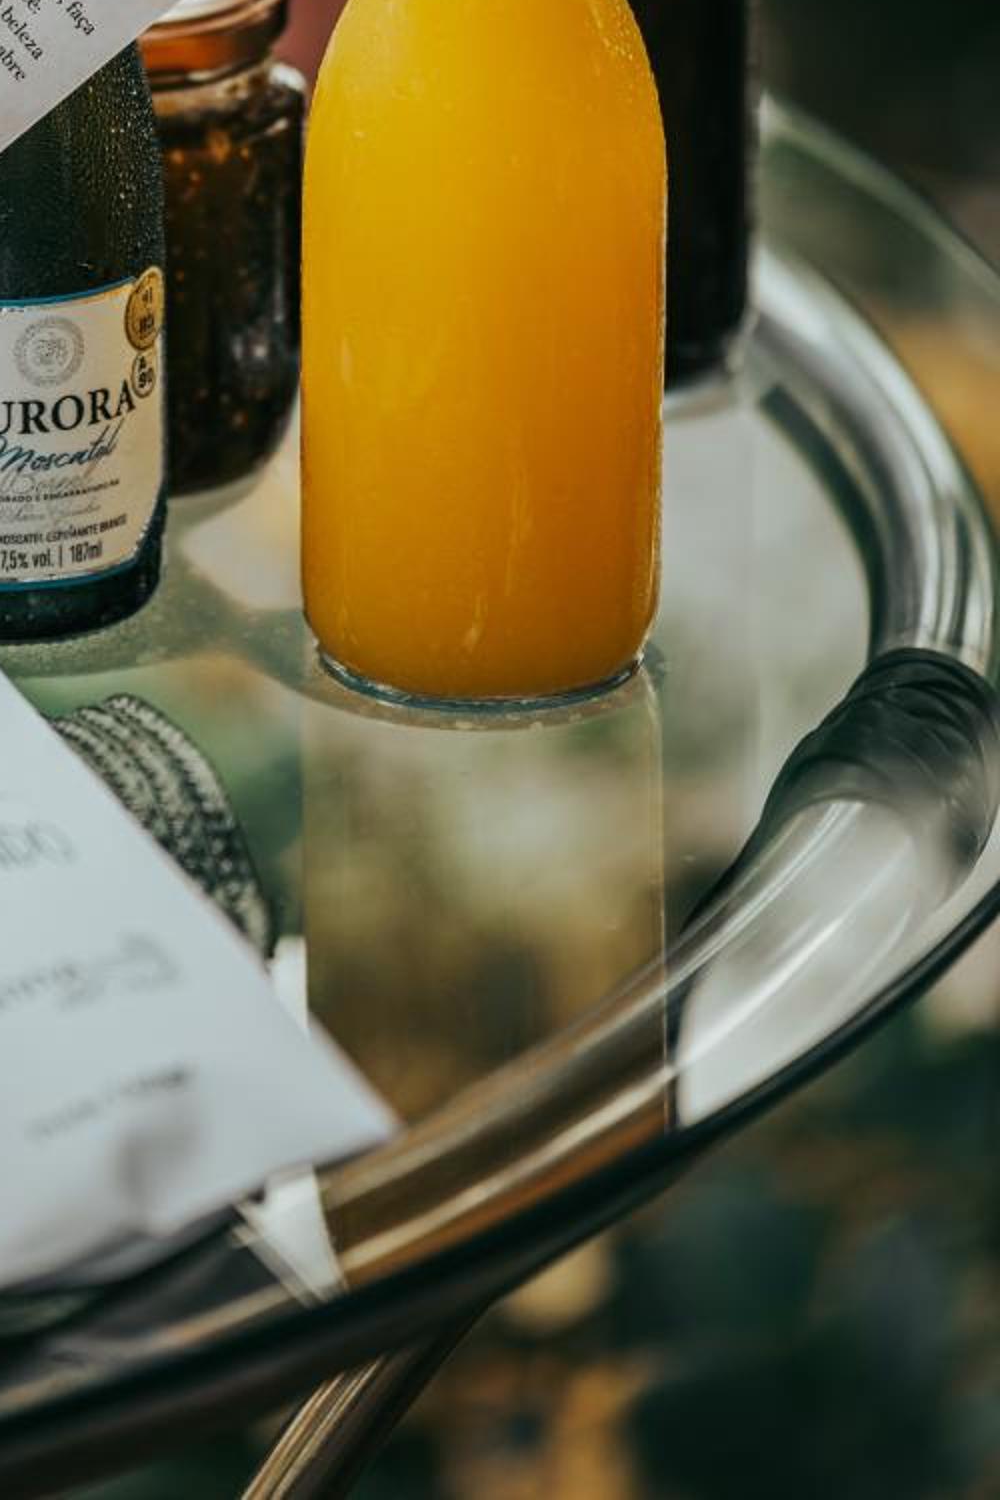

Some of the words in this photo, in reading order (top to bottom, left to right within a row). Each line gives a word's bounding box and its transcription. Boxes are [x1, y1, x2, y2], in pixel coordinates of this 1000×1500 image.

[0, 5, 44, 61] beleza
[65, 1, 98, 36] faça
[0, 549, 29, 573] 7,5%
[32, 547, 54, 568] vol.
[69, 539, 103, 563] 187ml
